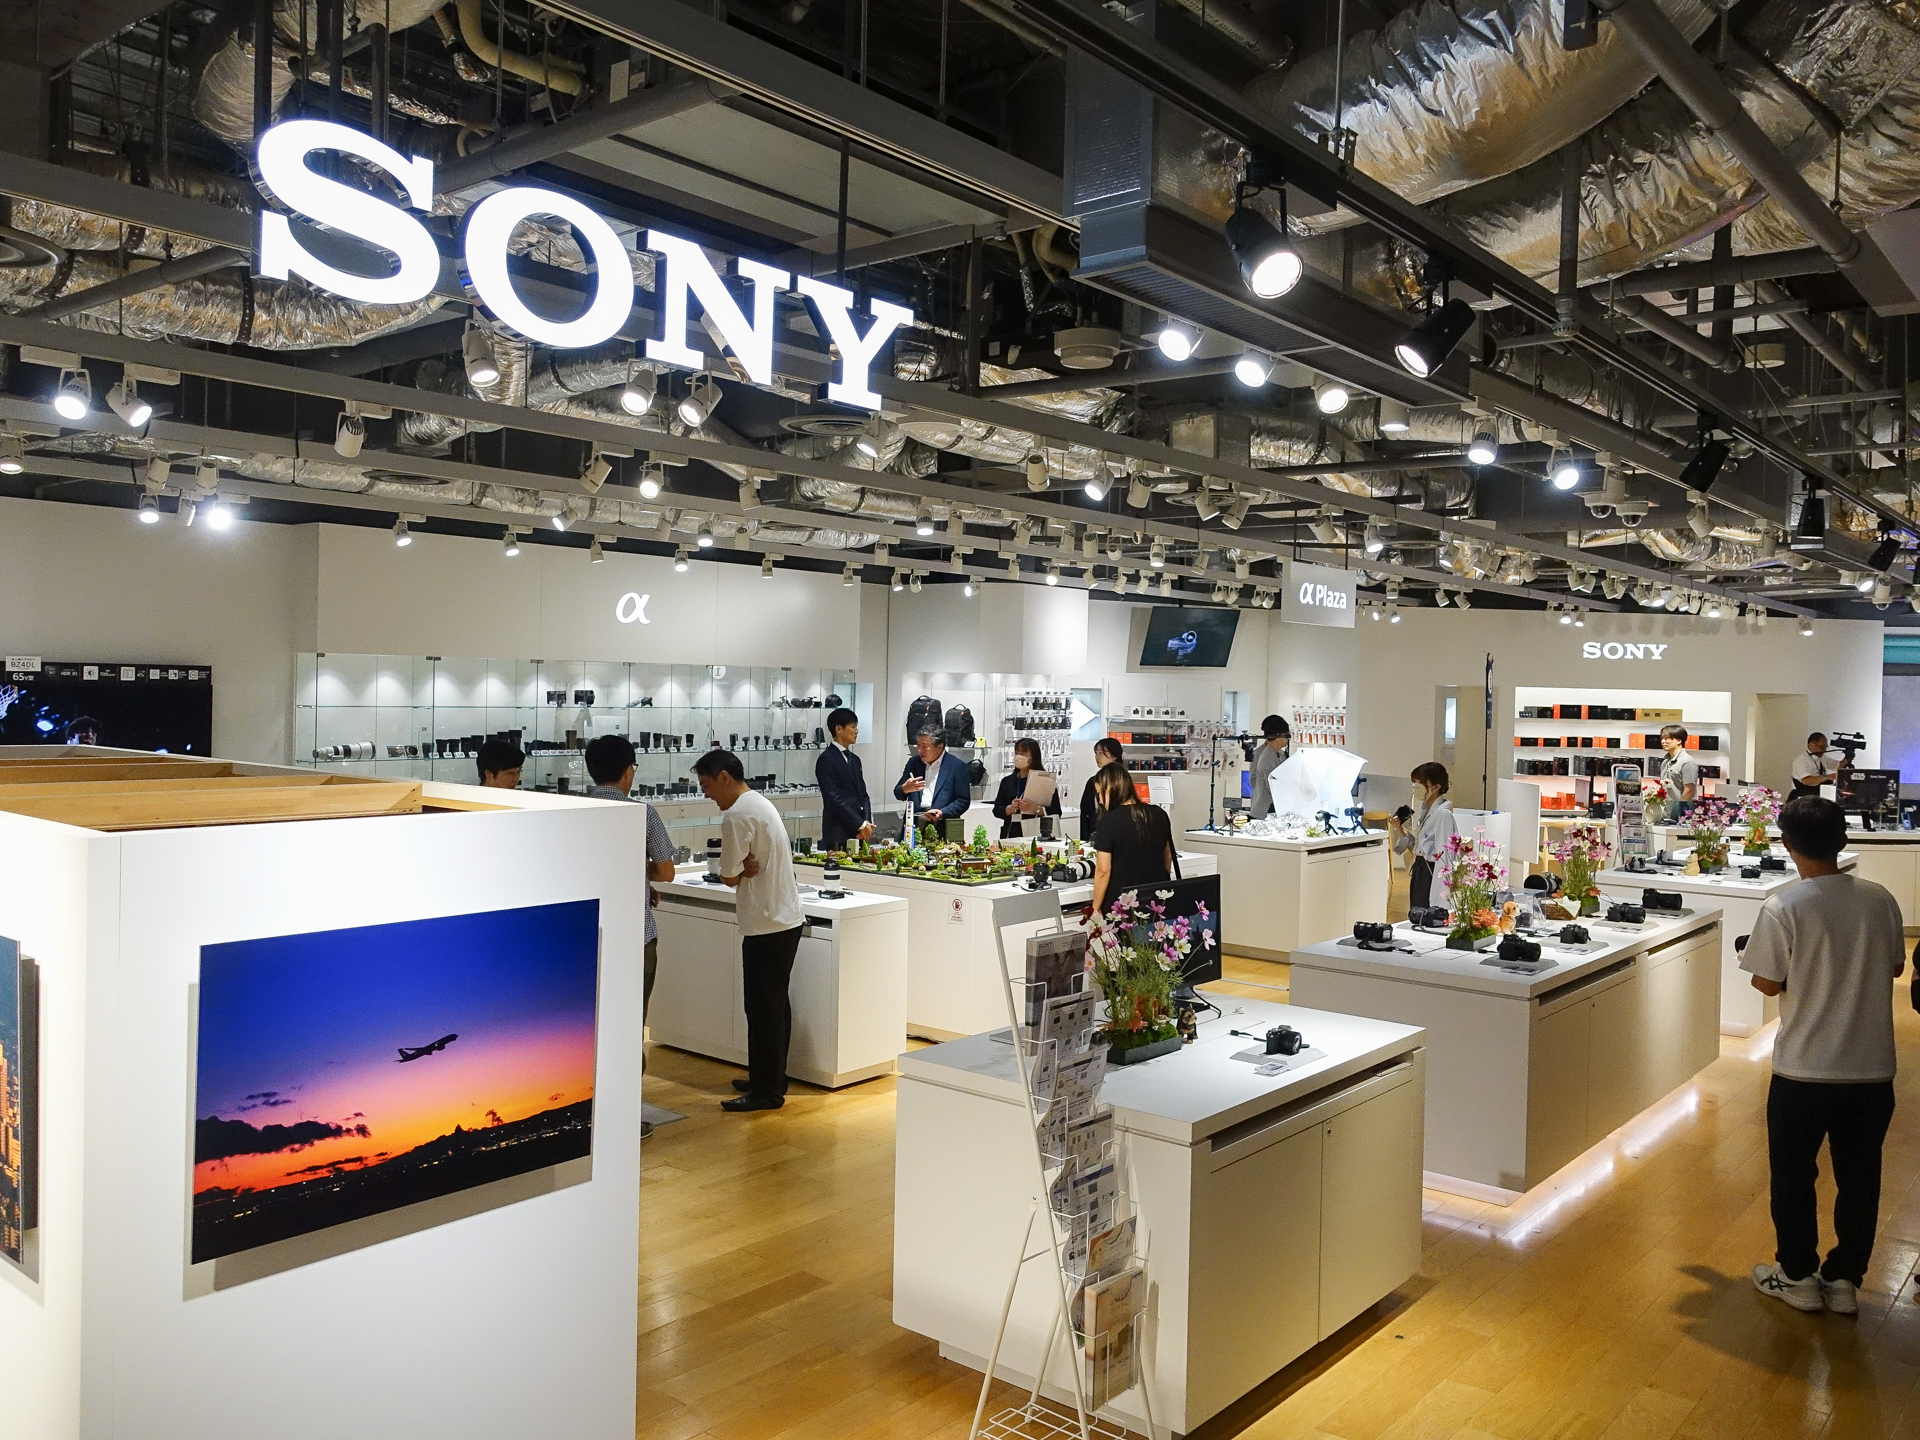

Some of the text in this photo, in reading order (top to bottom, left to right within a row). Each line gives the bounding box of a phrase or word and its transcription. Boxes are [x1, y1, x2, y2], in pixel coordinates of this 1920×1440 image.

[257, 120, 915, 412] SONY
[1315, 584, 1347, 609] Plaza
[1582, 641, 1668, 660] SONY
